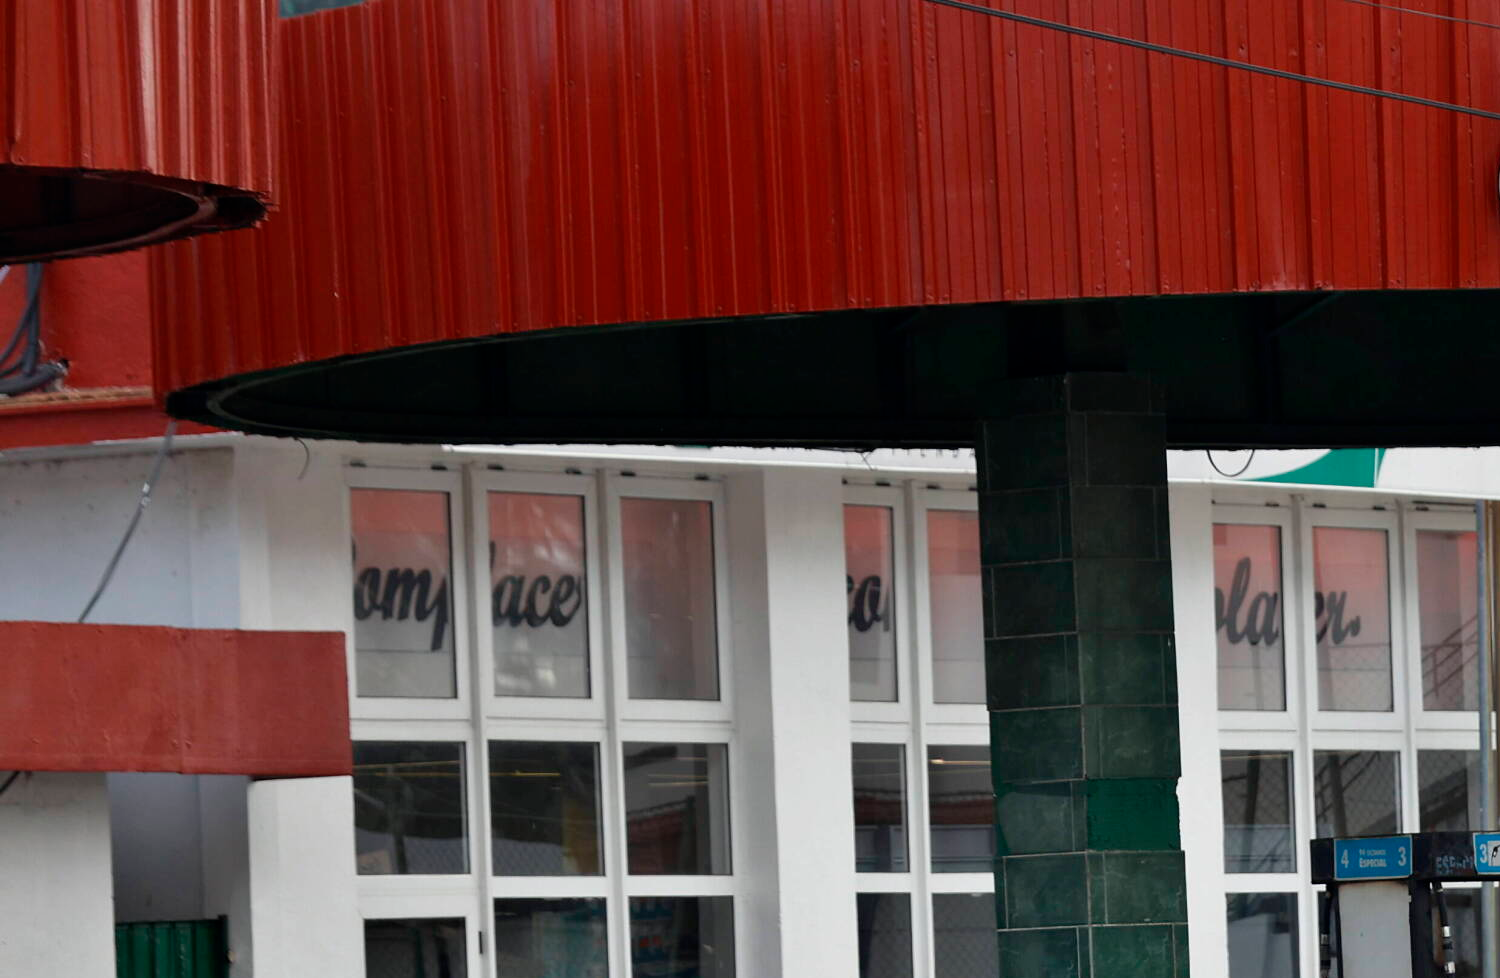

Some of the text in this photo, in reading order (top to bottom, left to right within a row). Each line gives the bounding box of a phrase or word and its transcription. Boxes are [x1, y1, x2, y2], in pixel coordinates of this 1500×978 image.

[1341, 849, 1349, 868] 4
[1397, 846, 1407, 866] 3
[1479, 844, 1488, 864] 3
